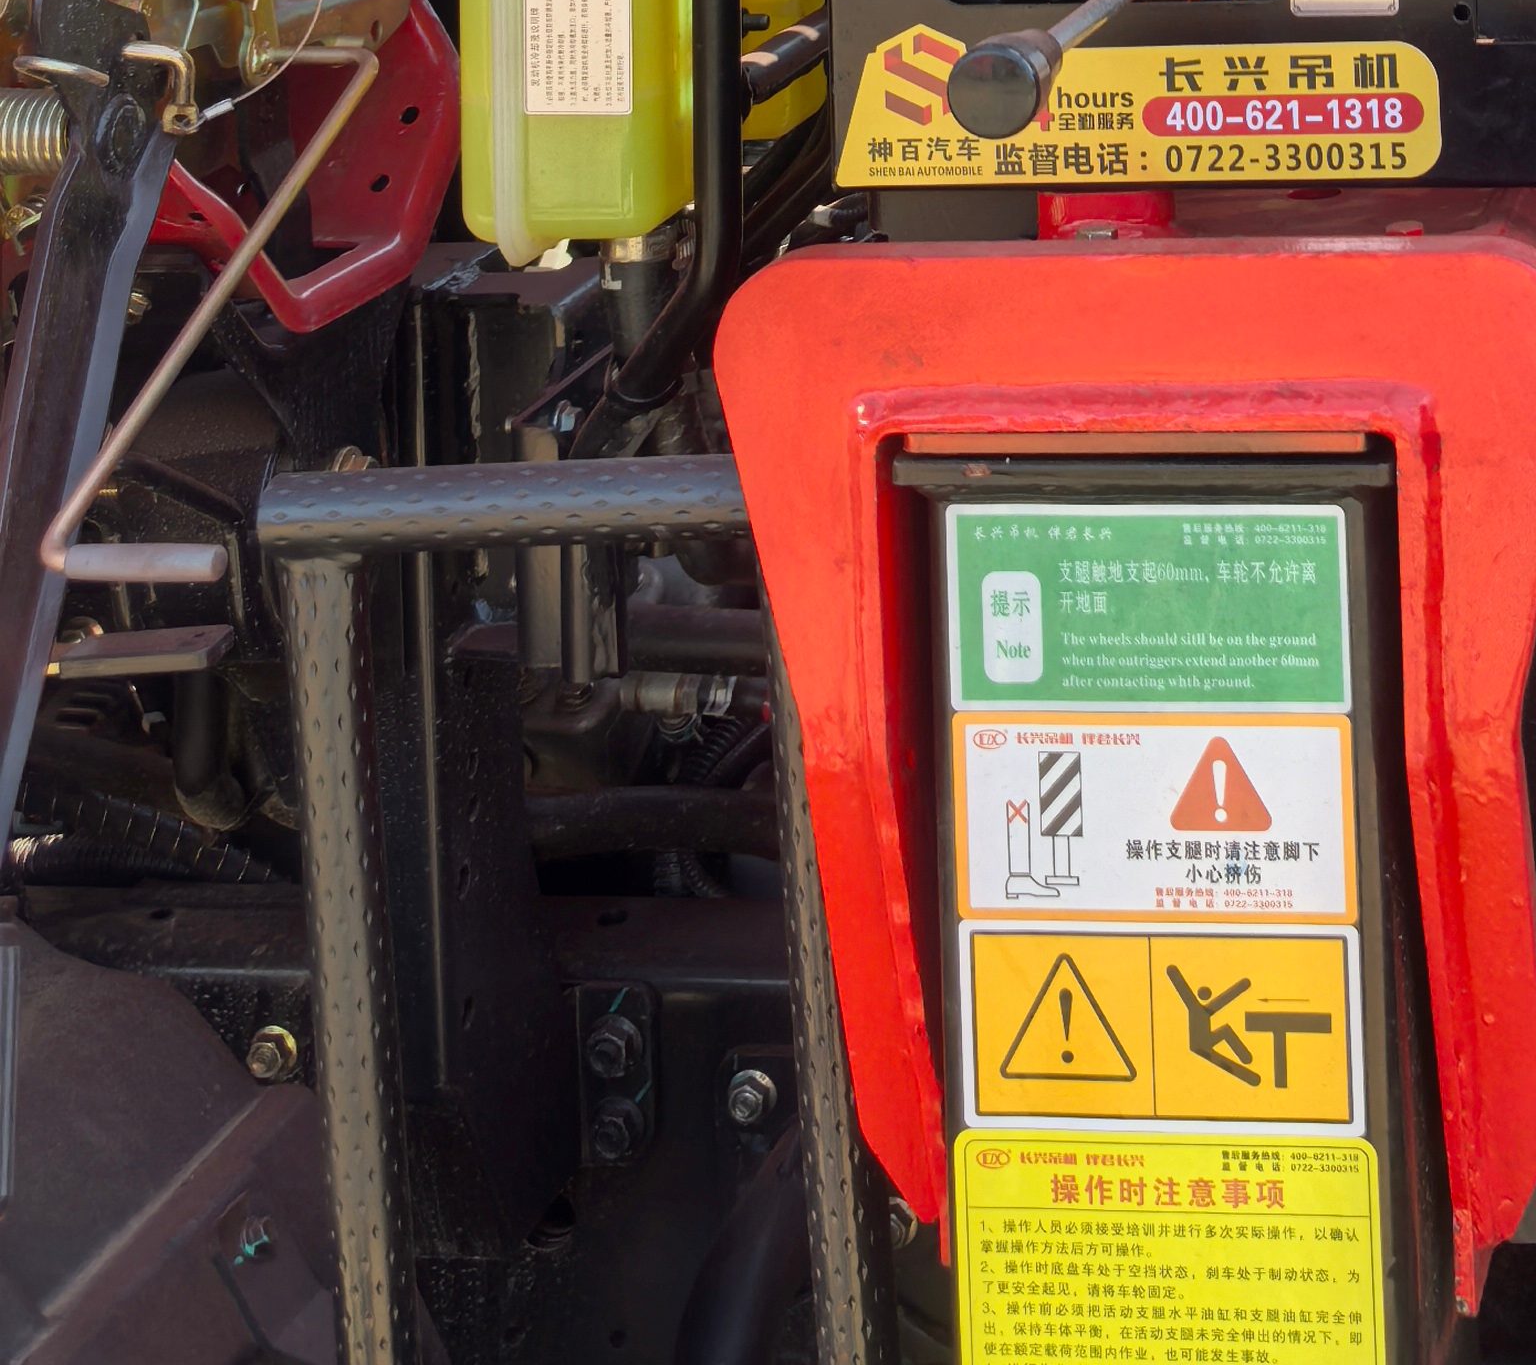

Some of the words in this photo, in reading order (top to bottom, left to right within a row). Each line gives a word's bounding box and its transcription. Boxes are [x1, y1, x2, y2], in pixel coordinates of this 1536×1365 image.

[1159, 53, 1399, 92] 长兴吊机
[1057, 87, 1135, 109] hours
[1059, 113, 1135, 131] 全勤服务
[1166, 97, 1404, 132] 400-621-1318
[867, 136, 981, 162] 神百汽车
[995, 142, 1148, 176] 监督电话：
[1166, 142, 1407, 173] 0722-3300315
[869, 167, 896, 177] SHEN
[899, 167, 916, 176] BAI
[917, 165, 983, 176] AUTOMOBILE
[974, 525, 1039, 540] 长兴吊机
[1048, 525, 1112, 540] 伴君长兴
[1254, 524, 1327, 533] 400-6211-318
[1255, 536, 1327, 545] 0722-3300315
[990, 589, 1031, 618] 提示
[1061, 632, 1086, 645] The
[1089, 634, 1132, 645] wheels
[1134, 634, 1178, 645] should
[1209, 634, 1223, 646] be
[1227, 637, 1242, 646] on
[1246, 634, 1266, 646] the
[1269, 634, 1317, 648] ground
[996, 639, 1031, 661] Note
[1062, 655, 1094, 666] when
[1097, 655, 1116, 666] the
[1118, 656, 1183, 669] outriggers
[1185, 656, 1227, 667] extend
[1229, 655, 1279, 667] another
[1280, 655, 1320, 667] 60mm
[1062, 676, 1093, 687] after
[1096, 676, 1165, 690] contacting
[1203, 676, 1255, 690] ground.
[1016, 732, 1073, 745] 长兴吊机
[1081, 733, 1140, 745] 伴君长兴
[1126, 839, 1320, 861] 操作支腿时请注意脚下
[1186, 864, 1262, 884] 小心挤伤
[1224, 900, 1293, 908] 0722-3300315
[1020, 1151, 1077, 1166] 长兴吊机
[1086, 1154, 1144, 1167] 伴君长兴
[1290, 1151, 1359, 1162] 400-6211-318
[1290, 1163, 1360, 1173] 0722-3300315
[1051, 1174, 1285, 1209] 操作时注意事项
[980, 1240, 1154, 1258] 掌握操作方法后方可操作。
[982, 1280, 1186, 1300] 了更安全起见，请将车轮固定。
[982, 1302, 1363, 1325] 3、操作前必须把活动支腿水平油缸和支腿油缸完全伸
[984, 1342, 1281, 1365] 使在额定载荷范围内作业，也可能发生事故。
